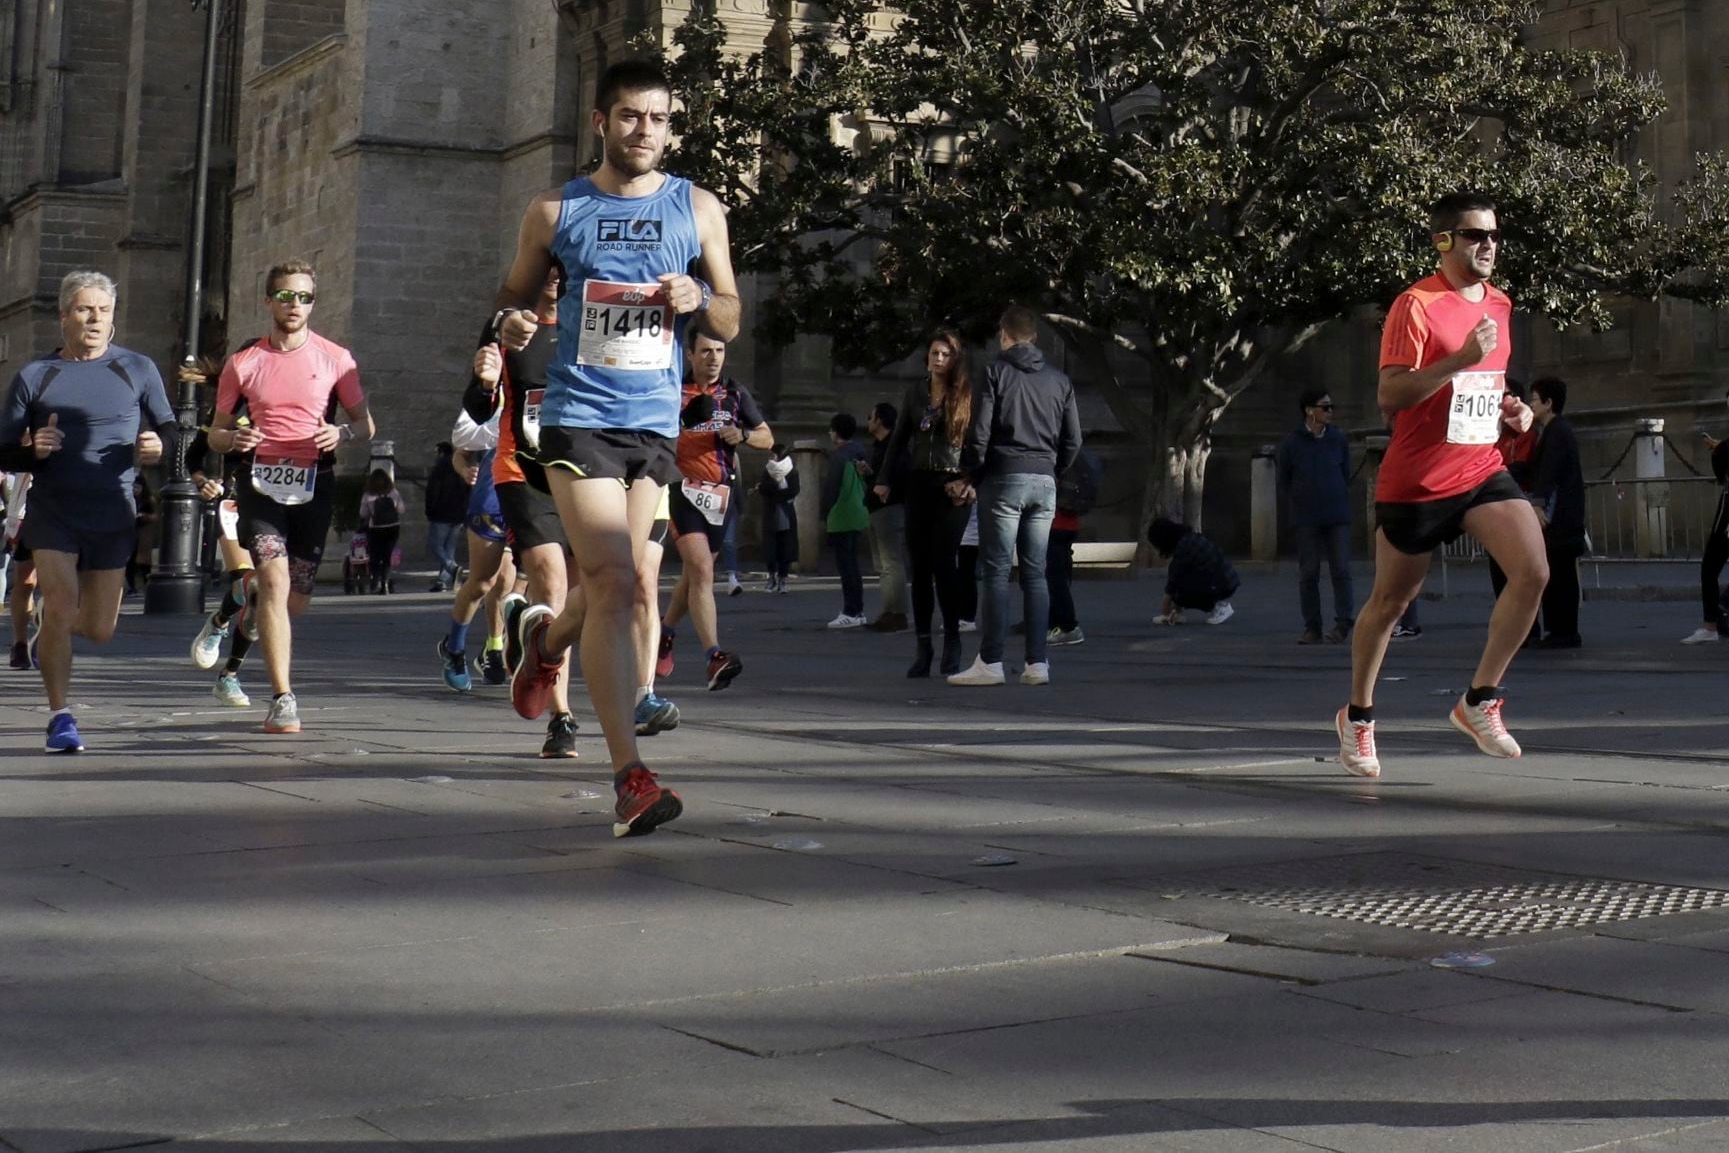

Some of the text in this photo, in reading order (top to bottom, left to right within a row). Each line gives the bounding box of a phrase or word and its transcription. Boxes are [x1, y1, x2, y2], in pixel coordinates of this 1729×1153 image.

[600, 221, 660, 240] FILA
[596, 243, 662, 251] ROAD RUNNER
[599, 307, 662, 338] 1418
[262, 467, 305, 486] 2284
[695, 493, 712, 509] 86
